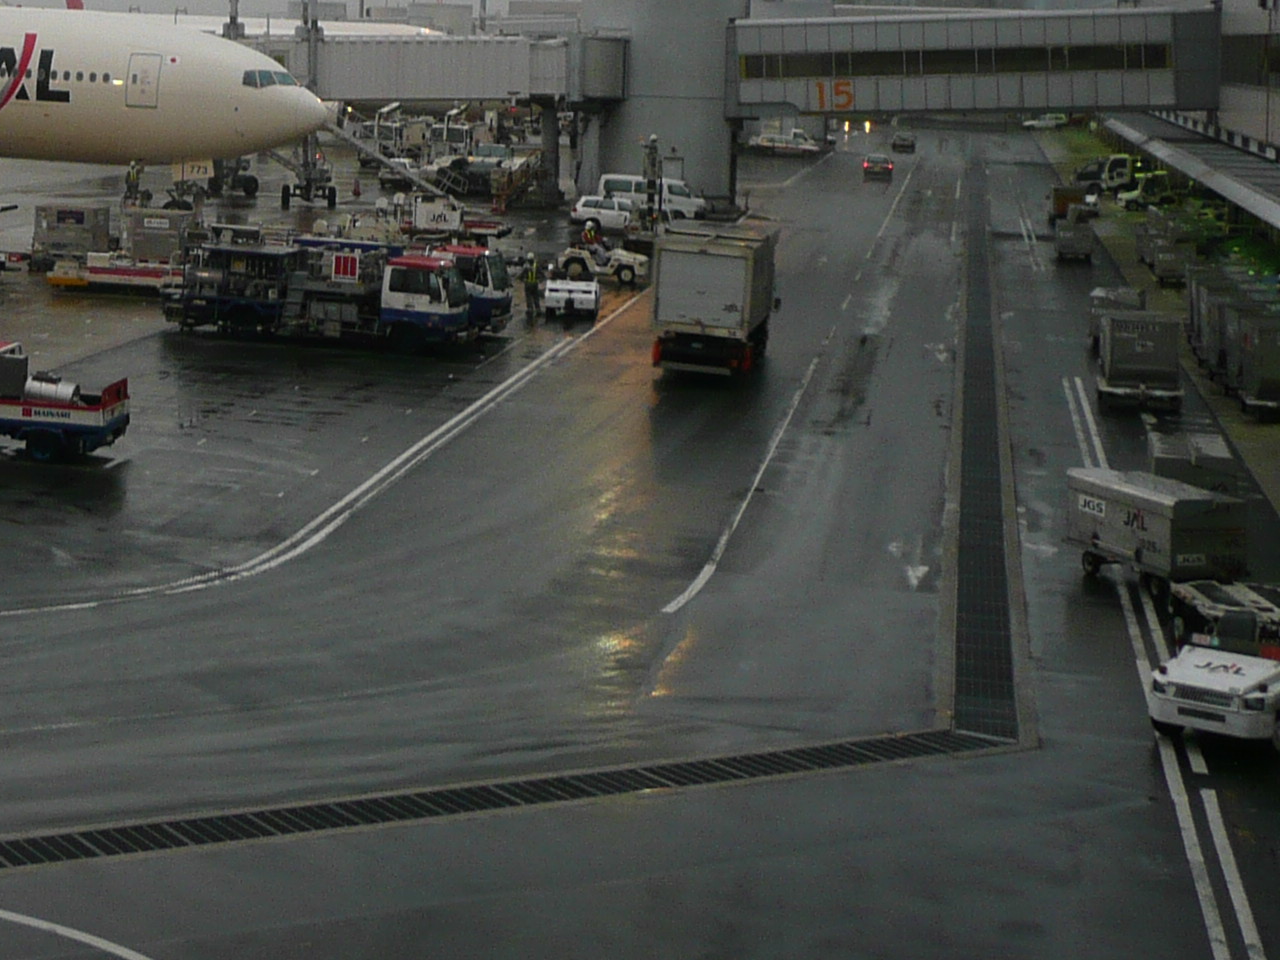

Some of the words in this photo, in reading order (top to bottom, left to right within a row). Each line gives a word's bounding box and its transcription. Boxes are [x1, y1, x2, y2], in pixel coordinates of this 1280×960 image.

[815, 81, 853, 110] 15
[1080, 497, 1104, 515] JGS
[1122, 507, 1148, 532] JAL
[1193, 661, 1246, 677] JAL
